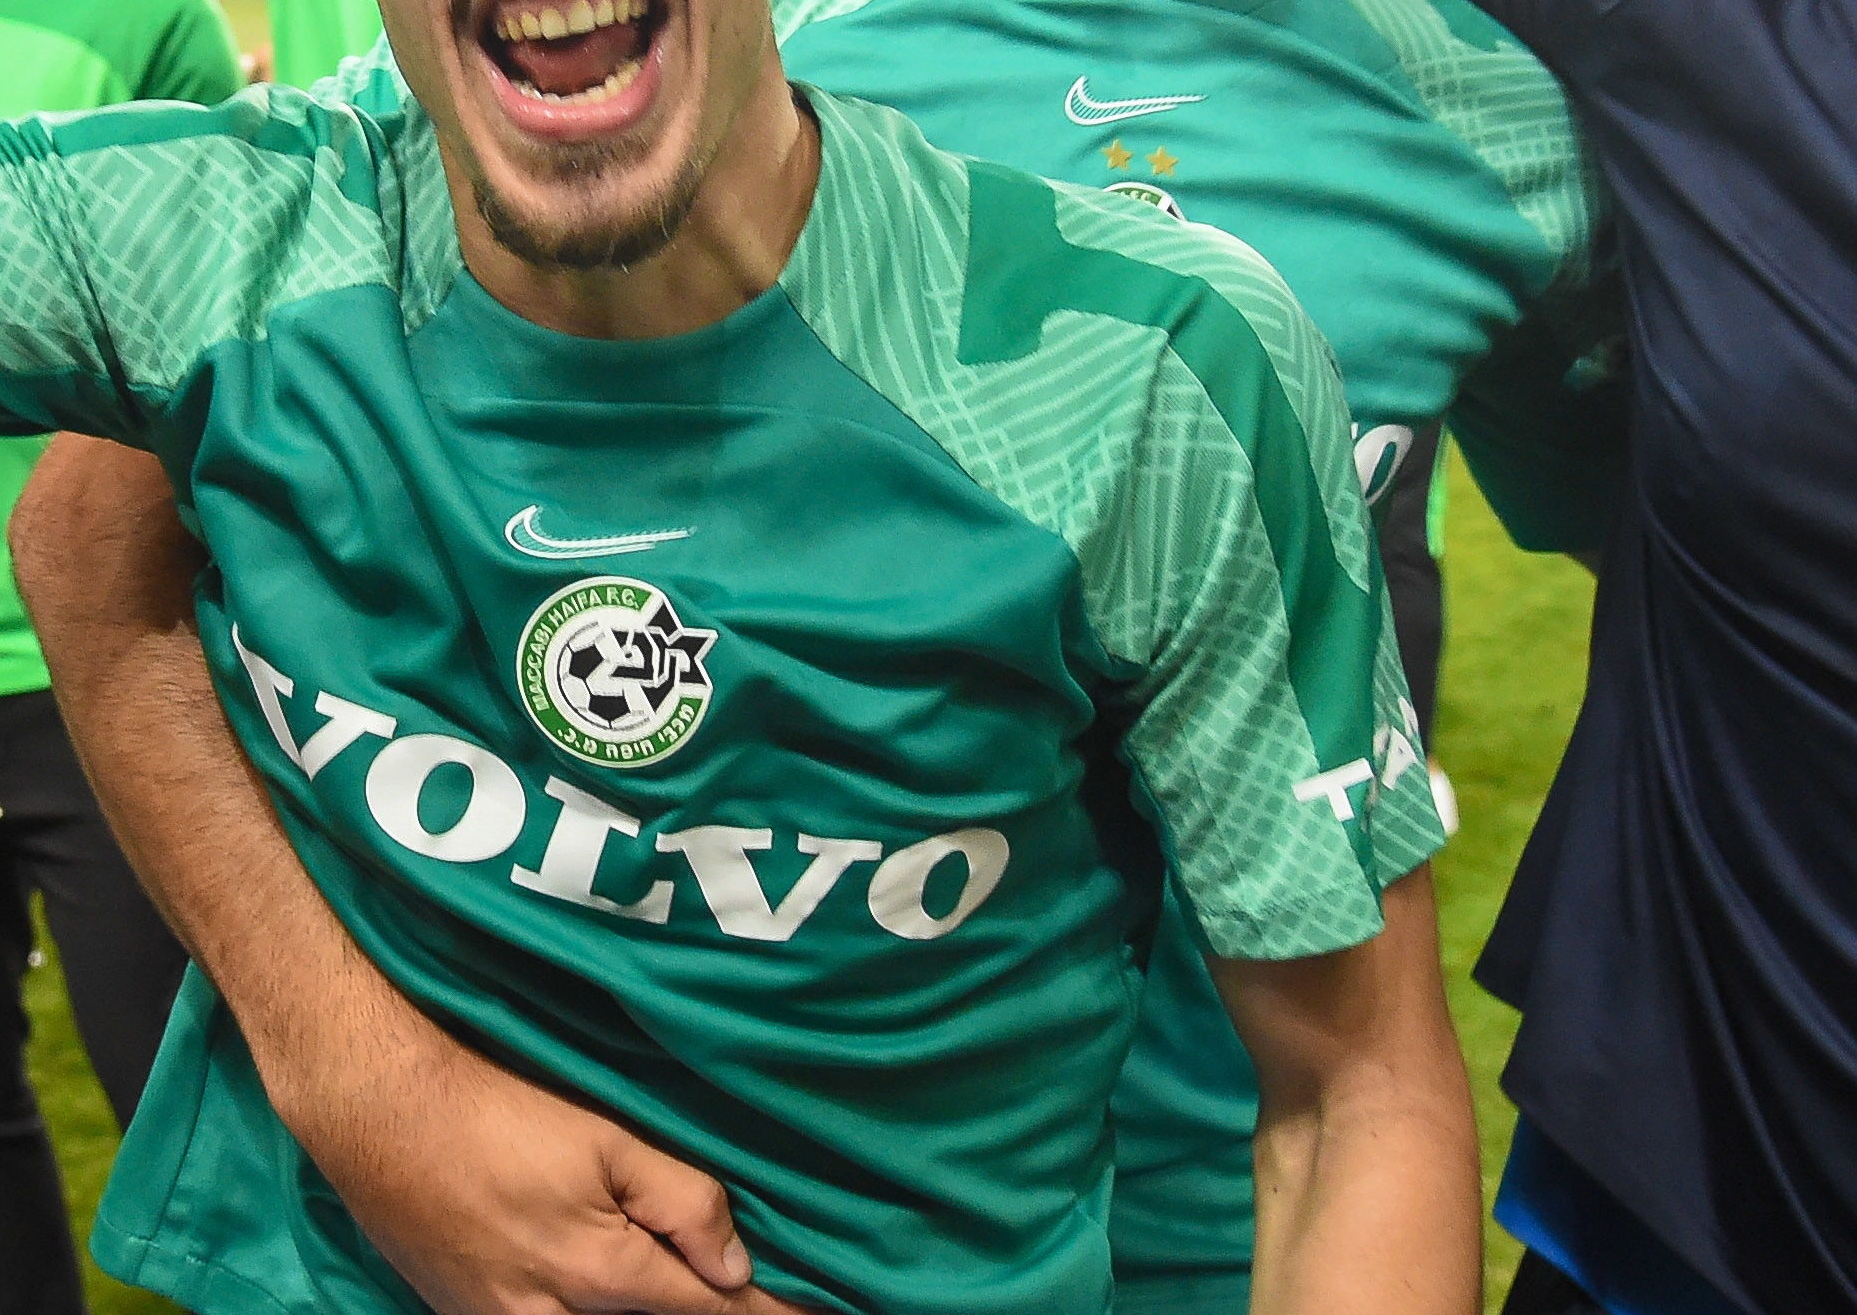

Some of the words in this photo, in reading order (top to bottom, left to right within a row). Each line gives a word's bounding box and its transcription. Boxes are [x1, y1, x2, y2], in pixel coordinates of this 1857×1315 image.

[526, 622, 554, 711] MACCABI
[547, 588, 603, 628] HAIFA
[605, 738, 655, 760] חיפה
[657, 703, 695, 743] מכבי
[231, 620, 1011, 942] VOLVO
